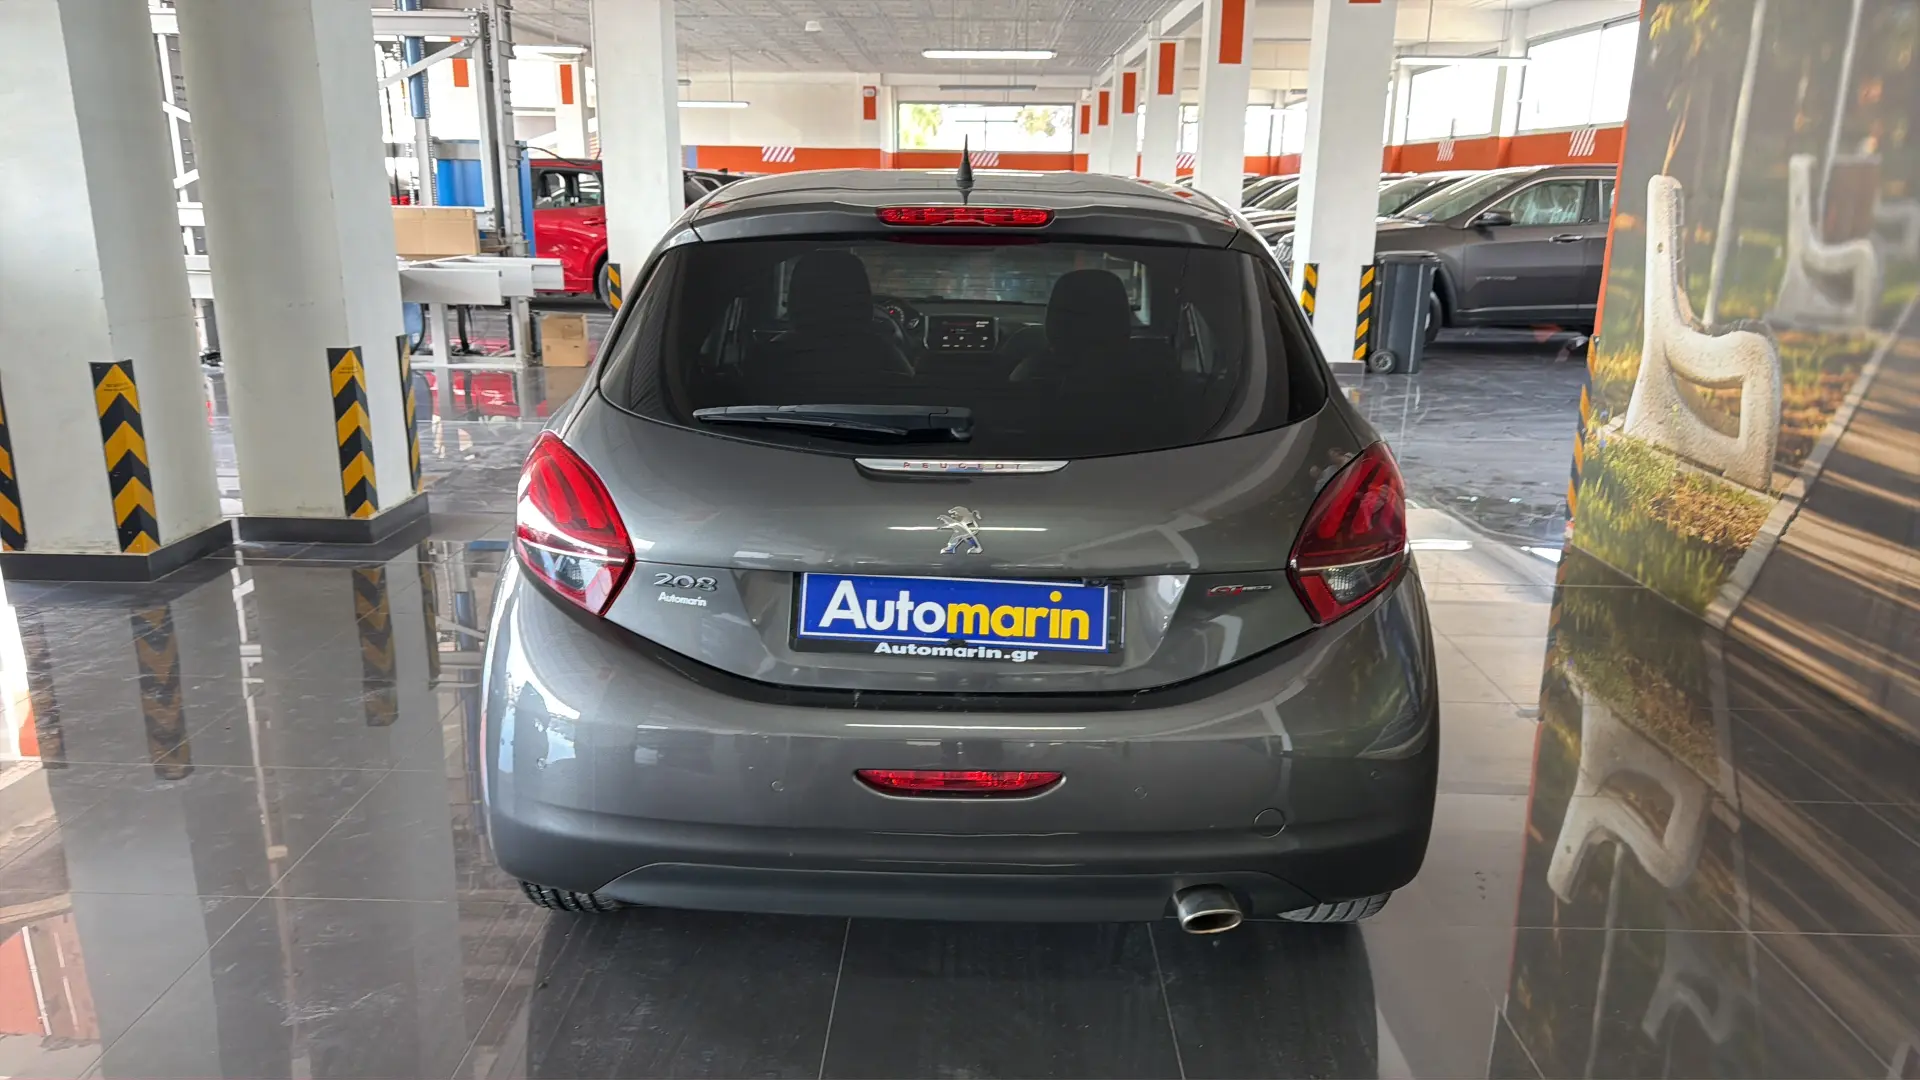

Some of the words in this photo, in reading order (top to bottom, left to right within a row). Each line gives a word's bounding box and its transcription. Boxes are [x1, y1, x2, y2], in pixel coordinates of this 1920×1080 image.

[903, 461, 1021, 469] PEUGEOT
[653, 572, 717, 591] 208
[658, 591, 707, 607] Automarin
[818, 580, 1090, 640] Automarin
[874, 641, 1039, 662] Automarin.gr
